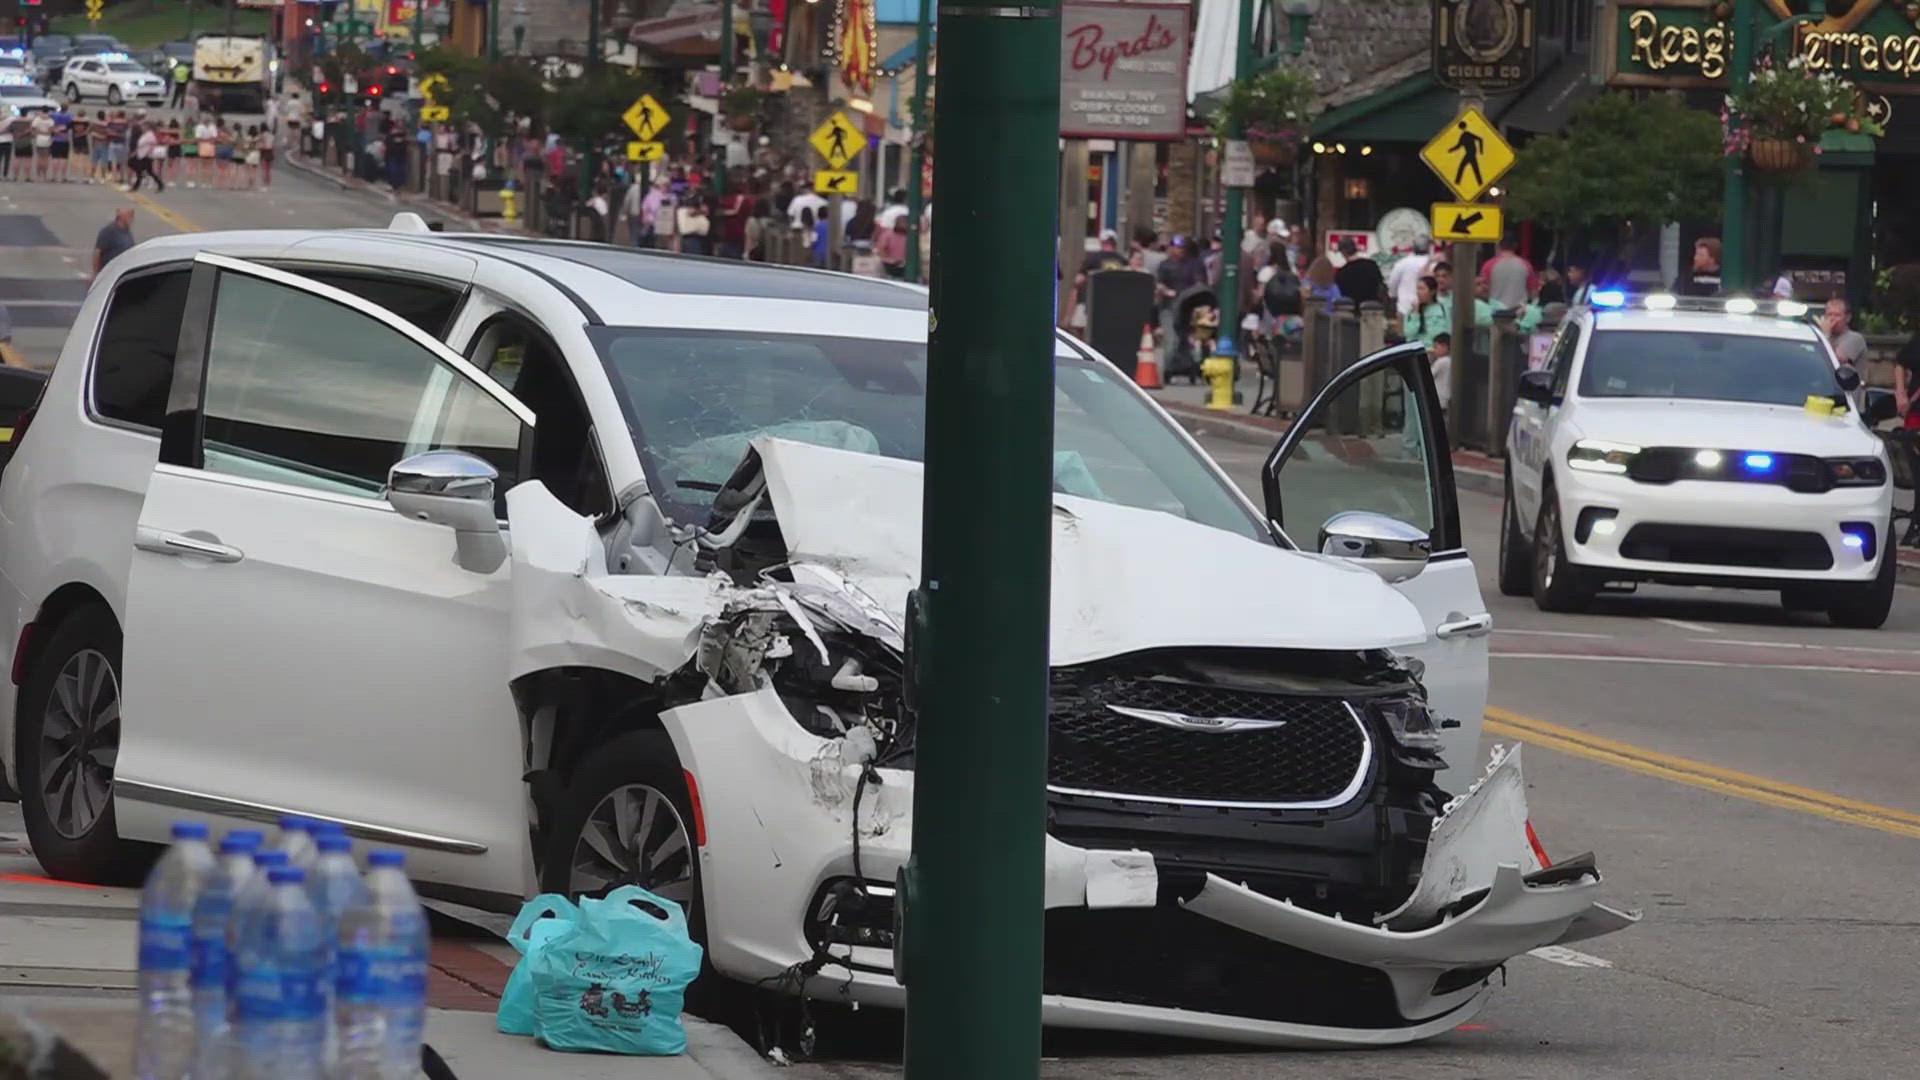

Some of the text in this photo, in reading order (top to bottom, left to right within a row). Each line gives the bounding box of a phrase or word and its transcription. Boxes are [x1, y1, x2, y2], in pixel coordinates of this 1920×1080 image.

[1067, 14, 1176, 81] Byrd's
[1447, 64, 1521, 79] CIDER CO
[1629, 9, 1734, 78] Reag
